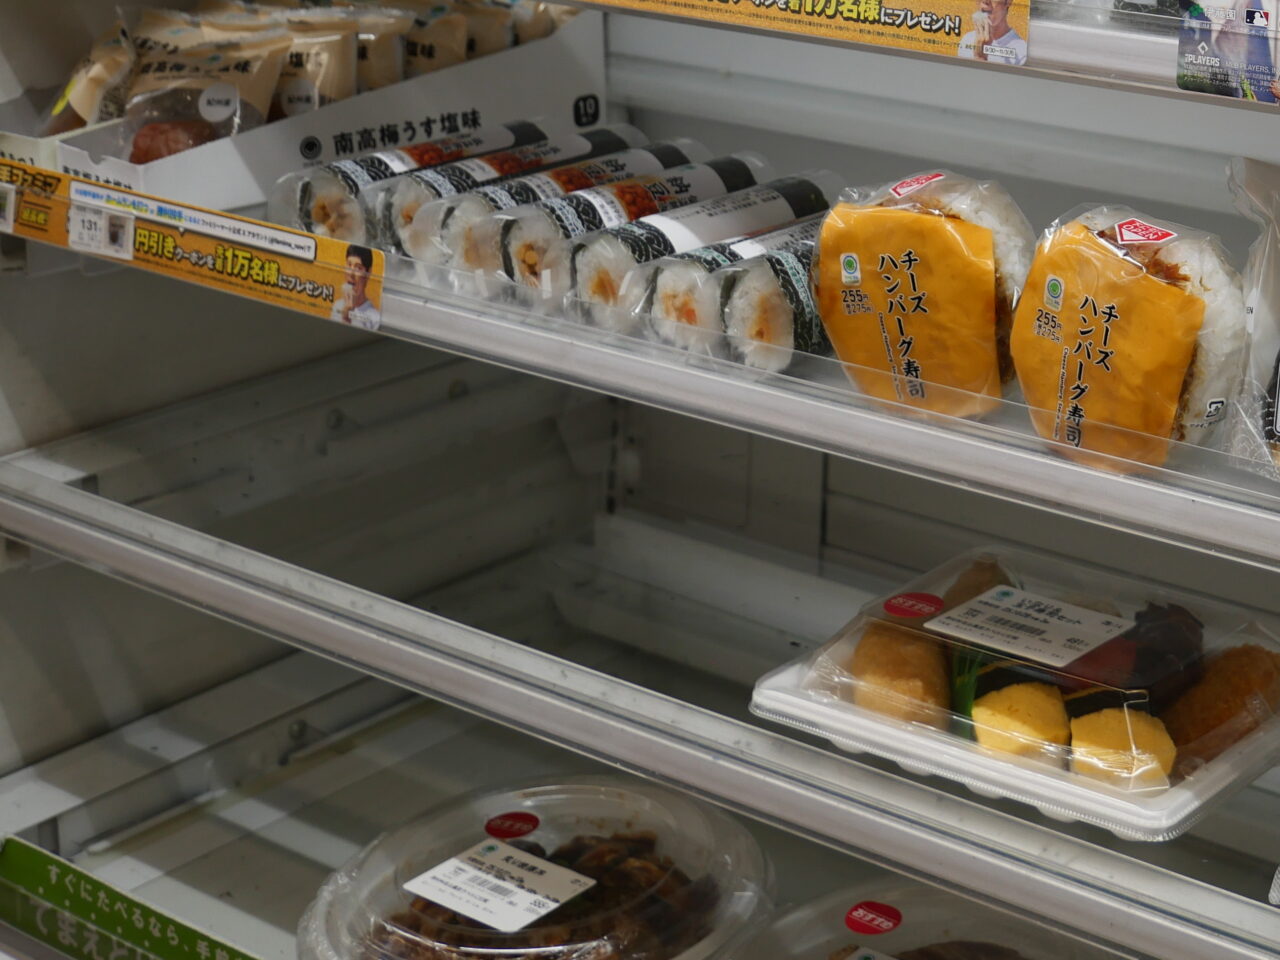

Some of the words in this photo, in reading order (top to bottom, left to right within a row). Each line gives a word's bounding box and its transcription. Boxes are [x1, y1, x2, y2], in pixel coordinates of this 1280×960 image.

[332, 107, 482, 157] 南高梅うす塩味
[840, 289, 869, 303] 255円
[900, 249, 929, 315] チーズ
[877, 254, 926, 400] ハンバーグ寿司
[1035, 308, 1063, 331] 255円
[1094, 303, 1121, 372] チーズ
[1064, 295, 1098, 448] ハンバーグ寿司
